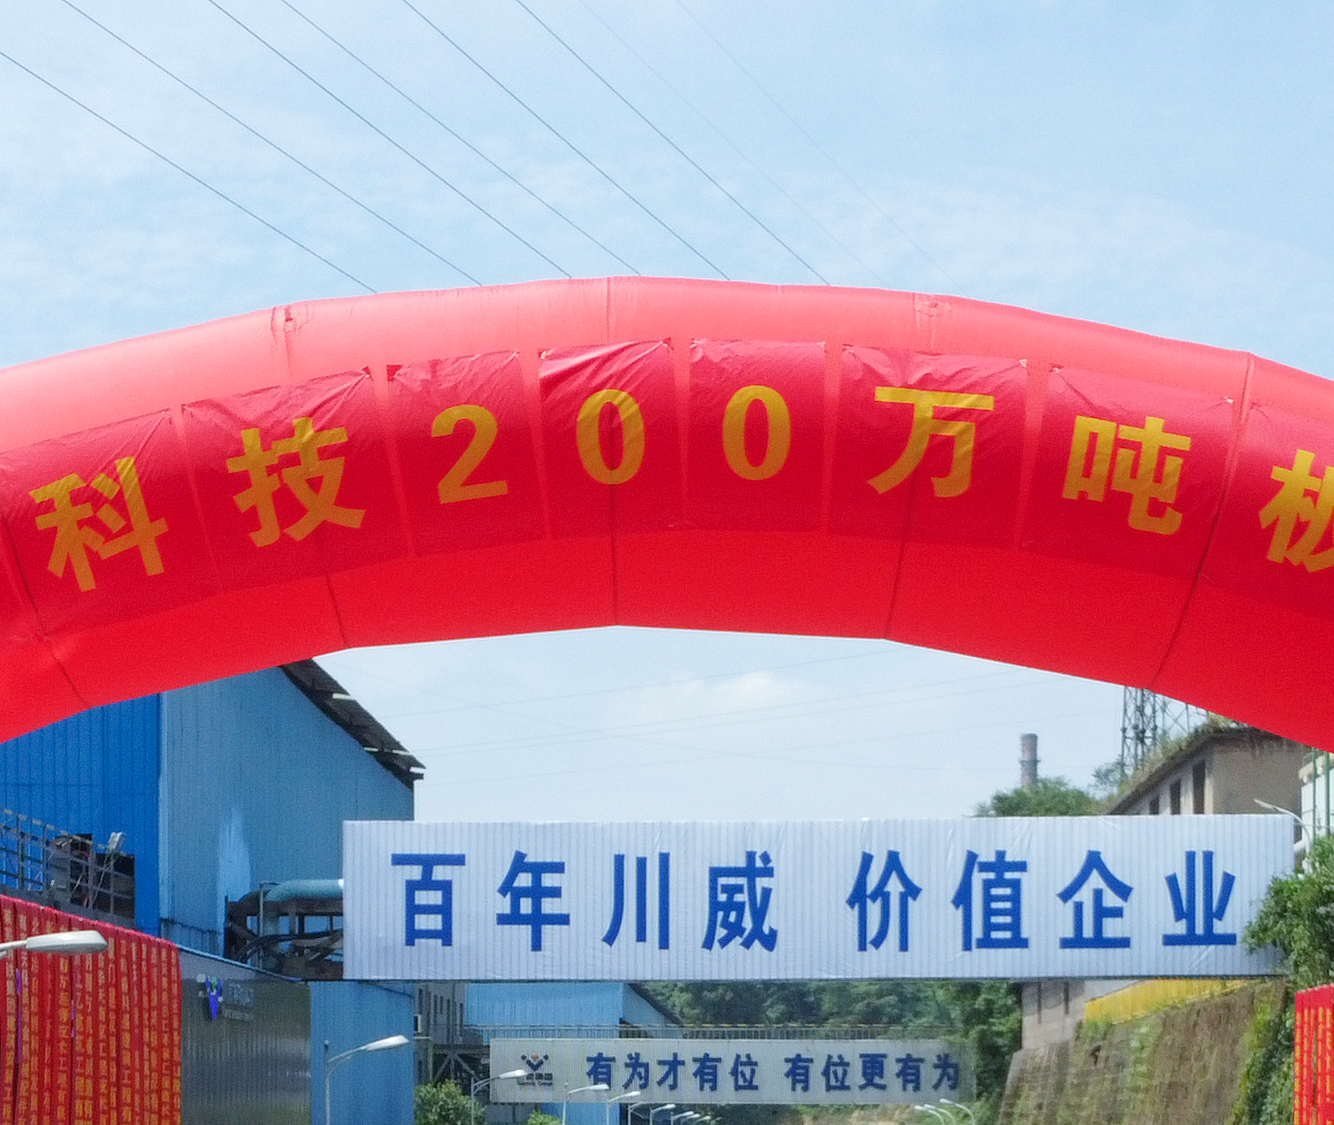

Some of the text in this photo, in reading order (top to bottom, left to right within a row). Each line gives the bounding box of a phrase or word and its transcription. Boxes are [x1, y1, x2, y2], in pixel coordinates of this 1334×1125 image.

[391, 850, 1238, 952] 百年川威 价值企业
[586, 1052, 960, 1092] 有为才有位 有位更有为
